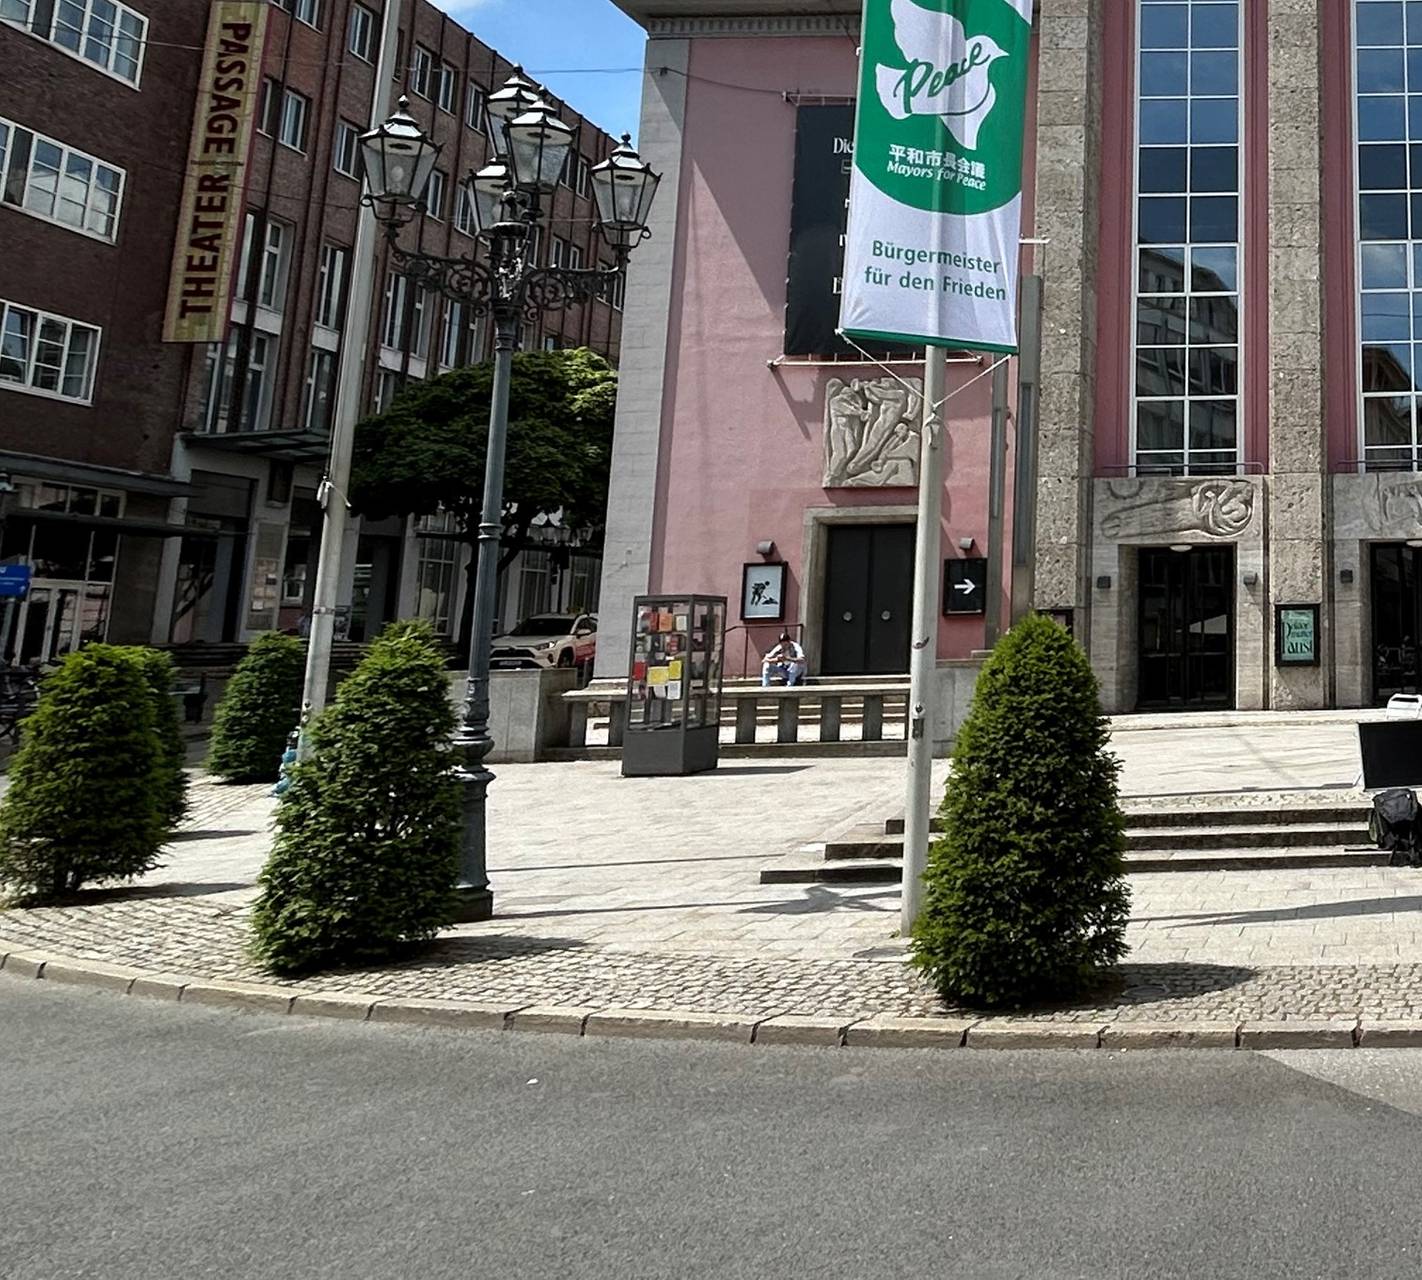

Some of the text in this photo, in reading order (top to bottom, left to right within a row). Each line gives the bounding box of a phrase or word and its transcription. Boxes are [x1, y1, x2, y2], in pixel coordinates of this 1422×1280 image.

[203, 22, 252, 154] PASSAGE
[893, 42, 991, 114] Peace
[887, 160, 986, 191] Mayors for Peace
[179, 173, 230, 319] THEATER
[872, 240, 1000, 274] Bürgermeister
[864, 266, 892, 286] für
[899, 271, 934, 290] den
[943, 276, 1006, 300] Frieden
